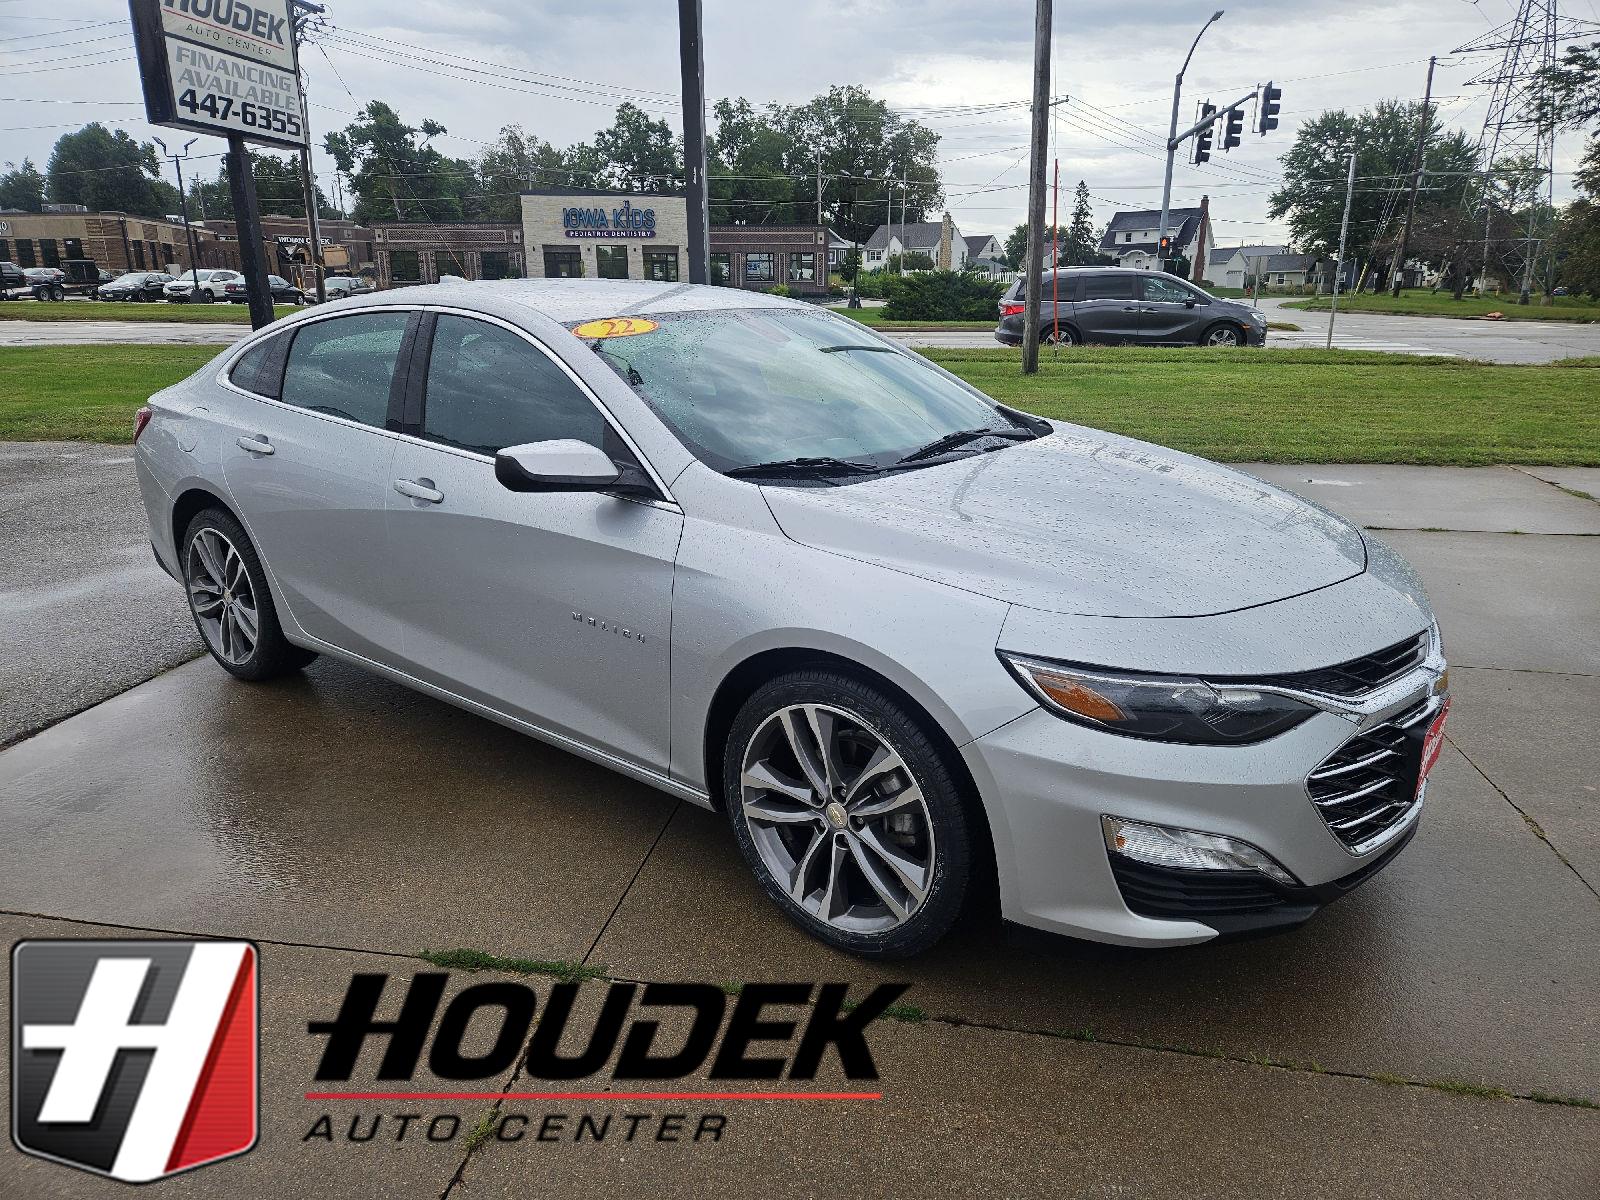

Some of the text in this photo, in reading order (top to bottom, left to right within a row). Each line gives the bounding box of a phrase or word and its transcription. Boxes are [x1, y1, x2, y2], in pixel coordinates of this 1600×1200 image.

[186, 23, 272, 55] AUTO CENTER
[176, 45, 291, 93] FINANCING
[178, 67, 296, 111] AVAILABLE
[179, 88, 301, 137] 447-6355
[562, 200, 656, 229] IOWA KIDS
[305, 237, 331, 245] CEK
[600, 319, 636, 336] 22
